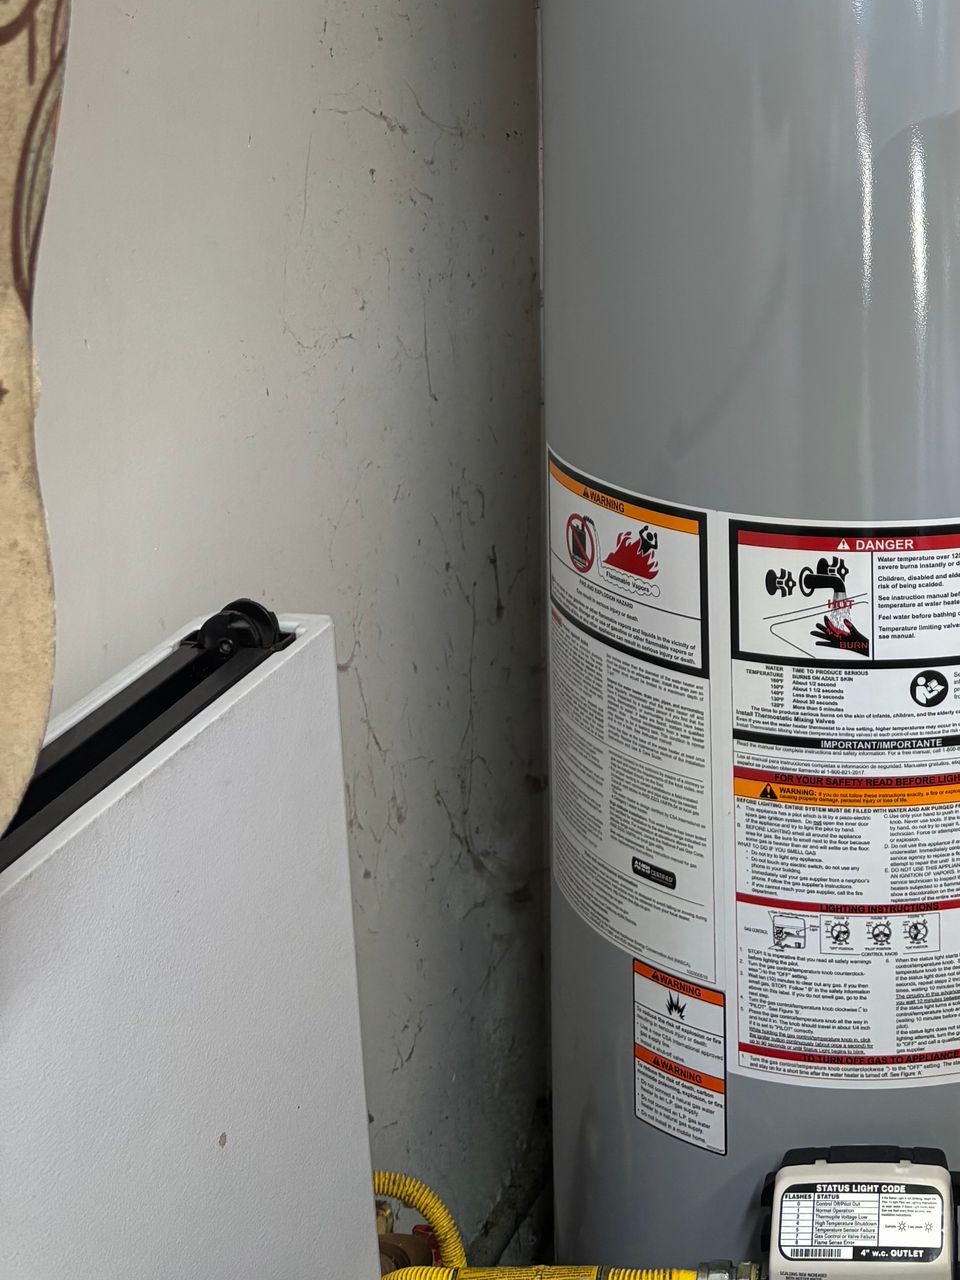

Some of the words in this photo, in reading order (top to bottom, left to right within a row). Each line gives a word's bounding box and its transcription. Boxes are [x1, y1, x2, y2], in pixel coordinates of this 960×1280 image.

[589, 491, 625, 513] WARNING
[855, 539, 914, 550] DANGER
[606, 571, 630, 586] Flammable
[632, 580, 650, 593] Vapors
[840, 642, 868, 650] BURN
[820, 738, 942, 750] IMPORTANT/IMPORTANTE
[774, 773, 794, 783] FOR
[796, 775, 824, 785] YOUR
[826, 778, 861, 788] SAFETY
[866, 778, 893, 788] READ
[896, 776, 937, 786] BEFORE
[779, 787, 817, 796] WARNING:
[820, 905, 865, 914] LIGHTING
[868, 902, 939, 914] INSTRUCTIONS
[659, 975, 701, 997] WARNING
[819, 1056, 844, 1064] TURN
[868, 1057, 888, 1065] GAS
[892, 1056, 904, 1064] TO
[906, 1050, 960, 1063] APPLIANCE
[660, 1061, 702, 1084] WARNING
